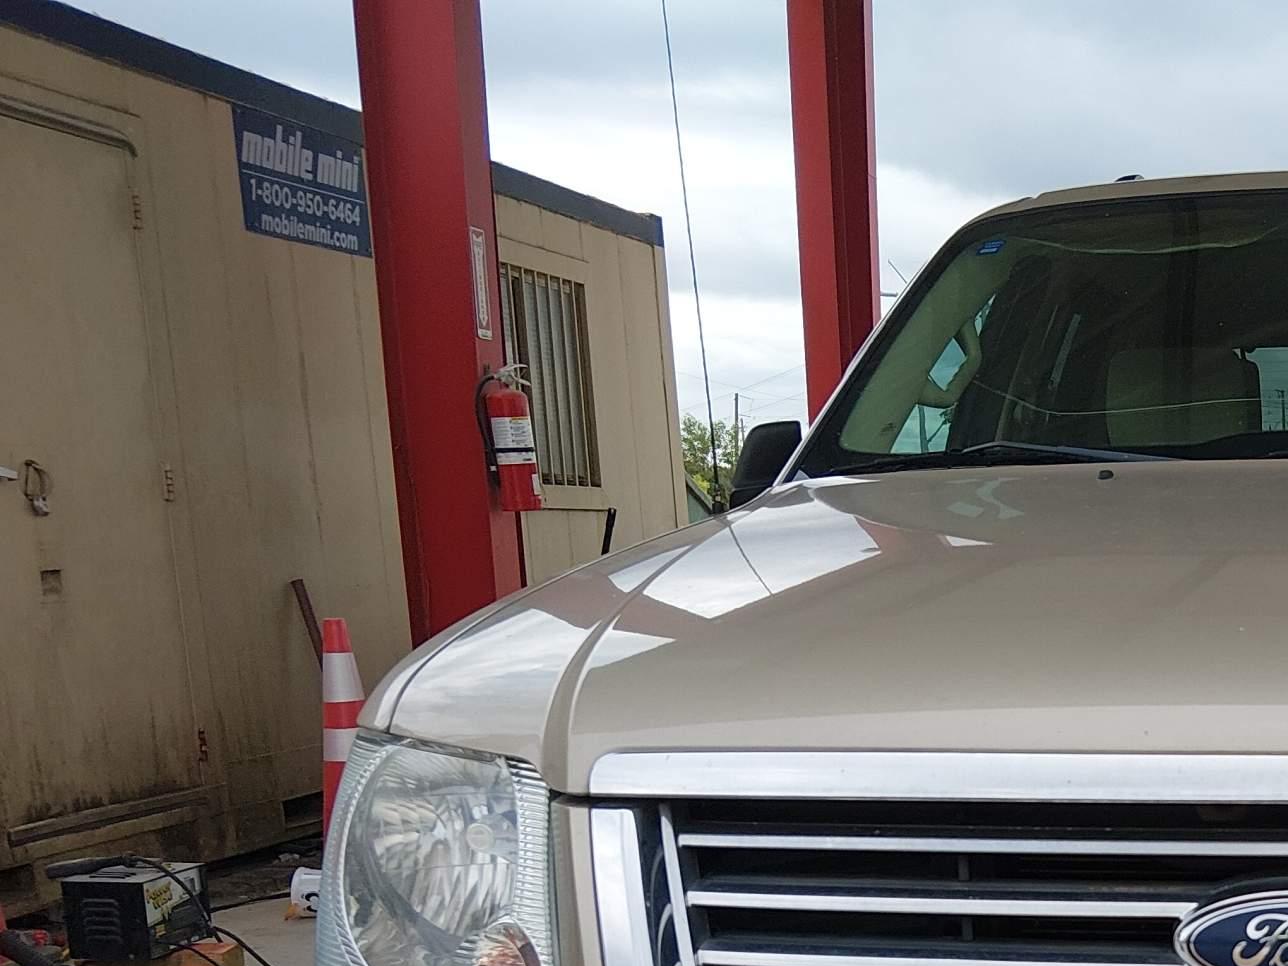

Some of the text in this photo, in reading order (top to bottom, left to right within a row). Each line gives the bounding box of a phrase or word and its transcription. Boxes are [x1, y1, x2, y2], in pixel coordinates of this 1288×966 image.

[241, 124, 360, 193] mobile mini
[250, 177, 361, 227] 1-800-950-6464
[261, 212, 359, 251] mobilemini.com
